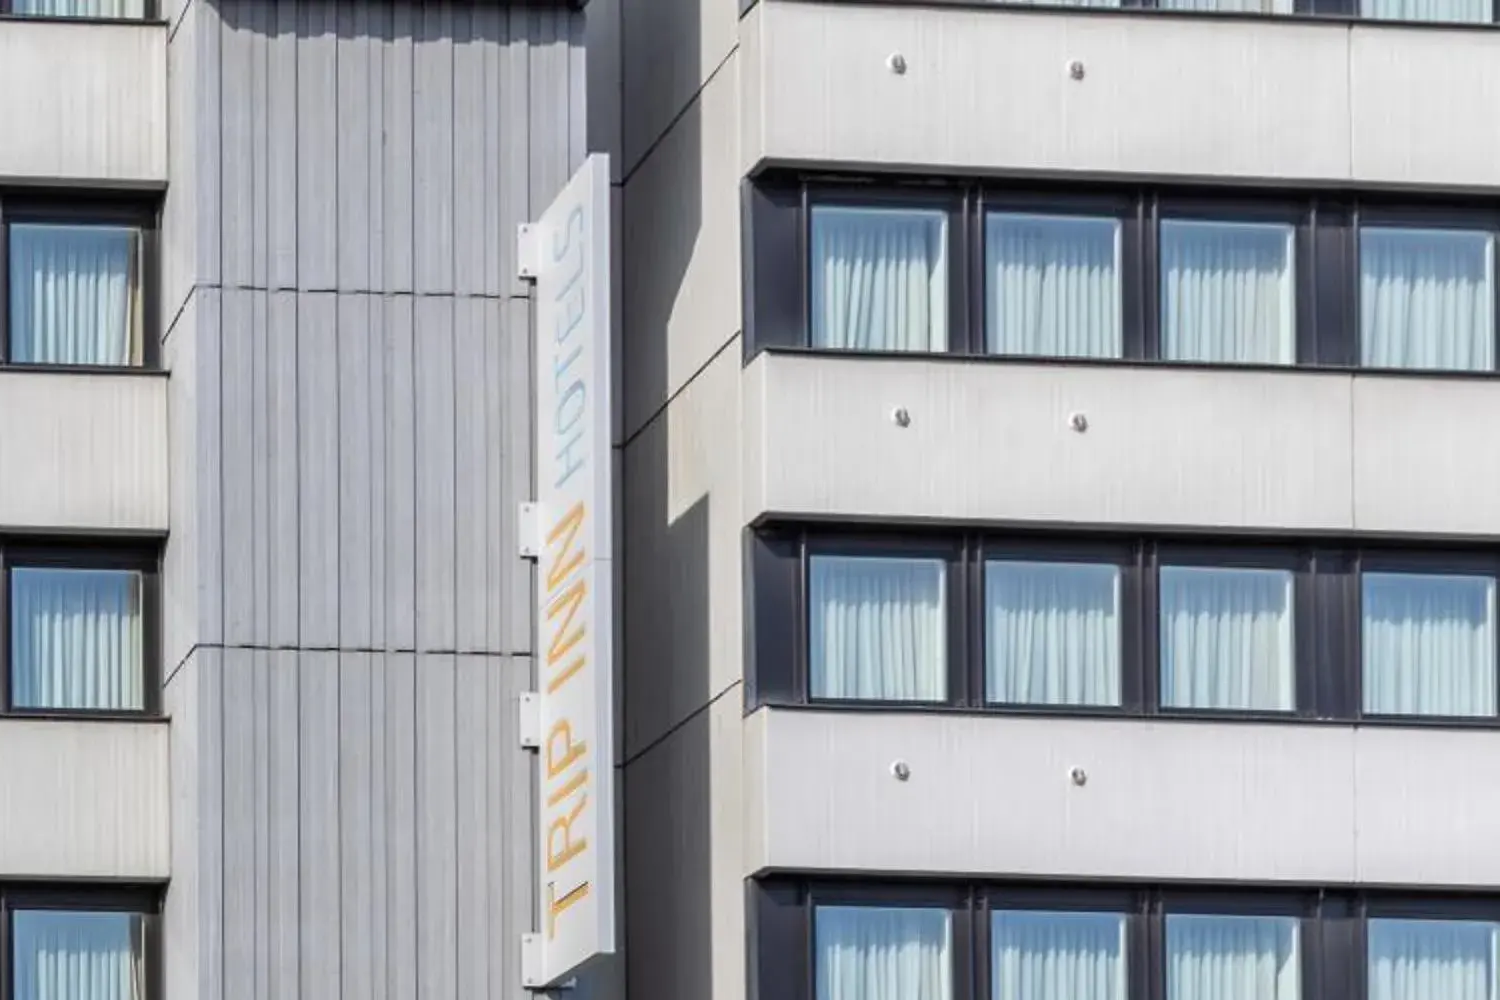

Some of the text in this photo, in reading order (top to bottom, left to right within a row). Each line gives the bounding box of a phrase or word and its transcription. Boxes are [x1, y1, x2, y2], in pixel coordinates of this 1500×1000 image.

[546, 205, 590, 941] TRIP INN HOTELS
